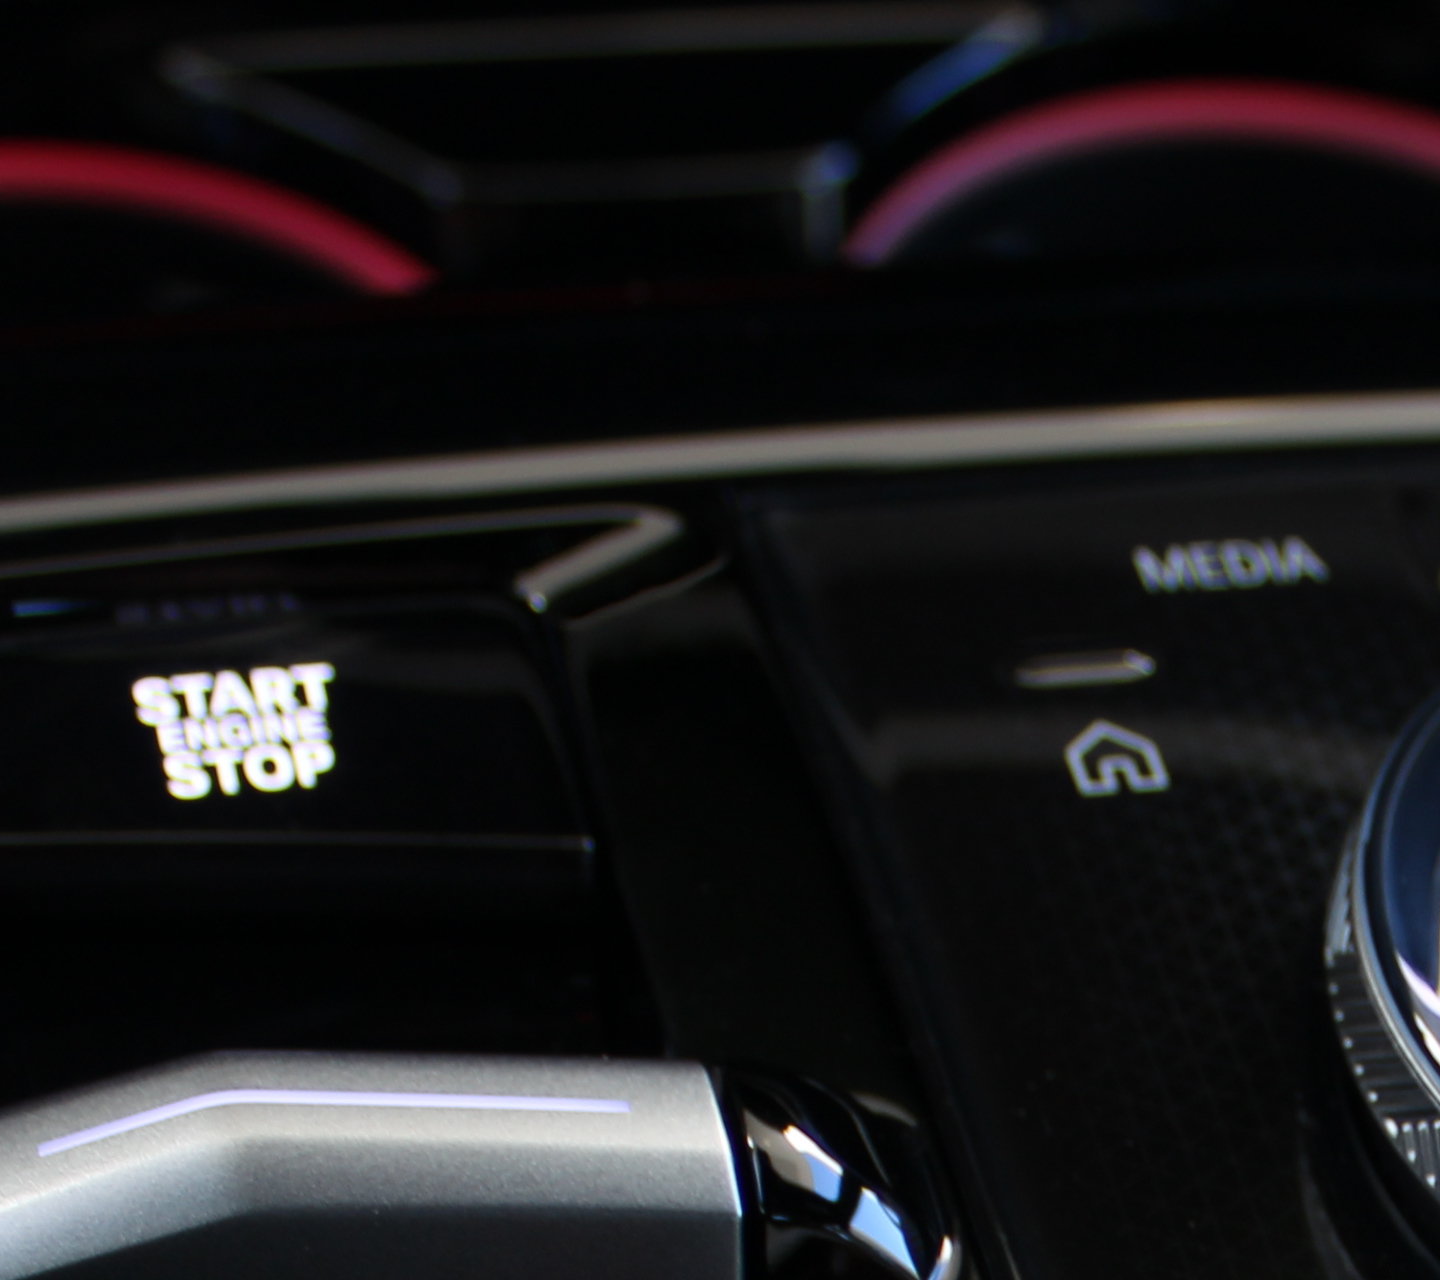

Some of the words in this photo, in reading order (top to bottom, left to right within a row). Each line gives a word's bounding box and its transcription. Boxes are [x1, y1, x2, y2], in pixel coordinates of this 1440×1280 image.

[1133, 536, 1328, 592] MEDIA
[132, 663, 335, 726] START
[158, 709, 331, 755] ENGINE
[161, 742, 335, 800] STOP
